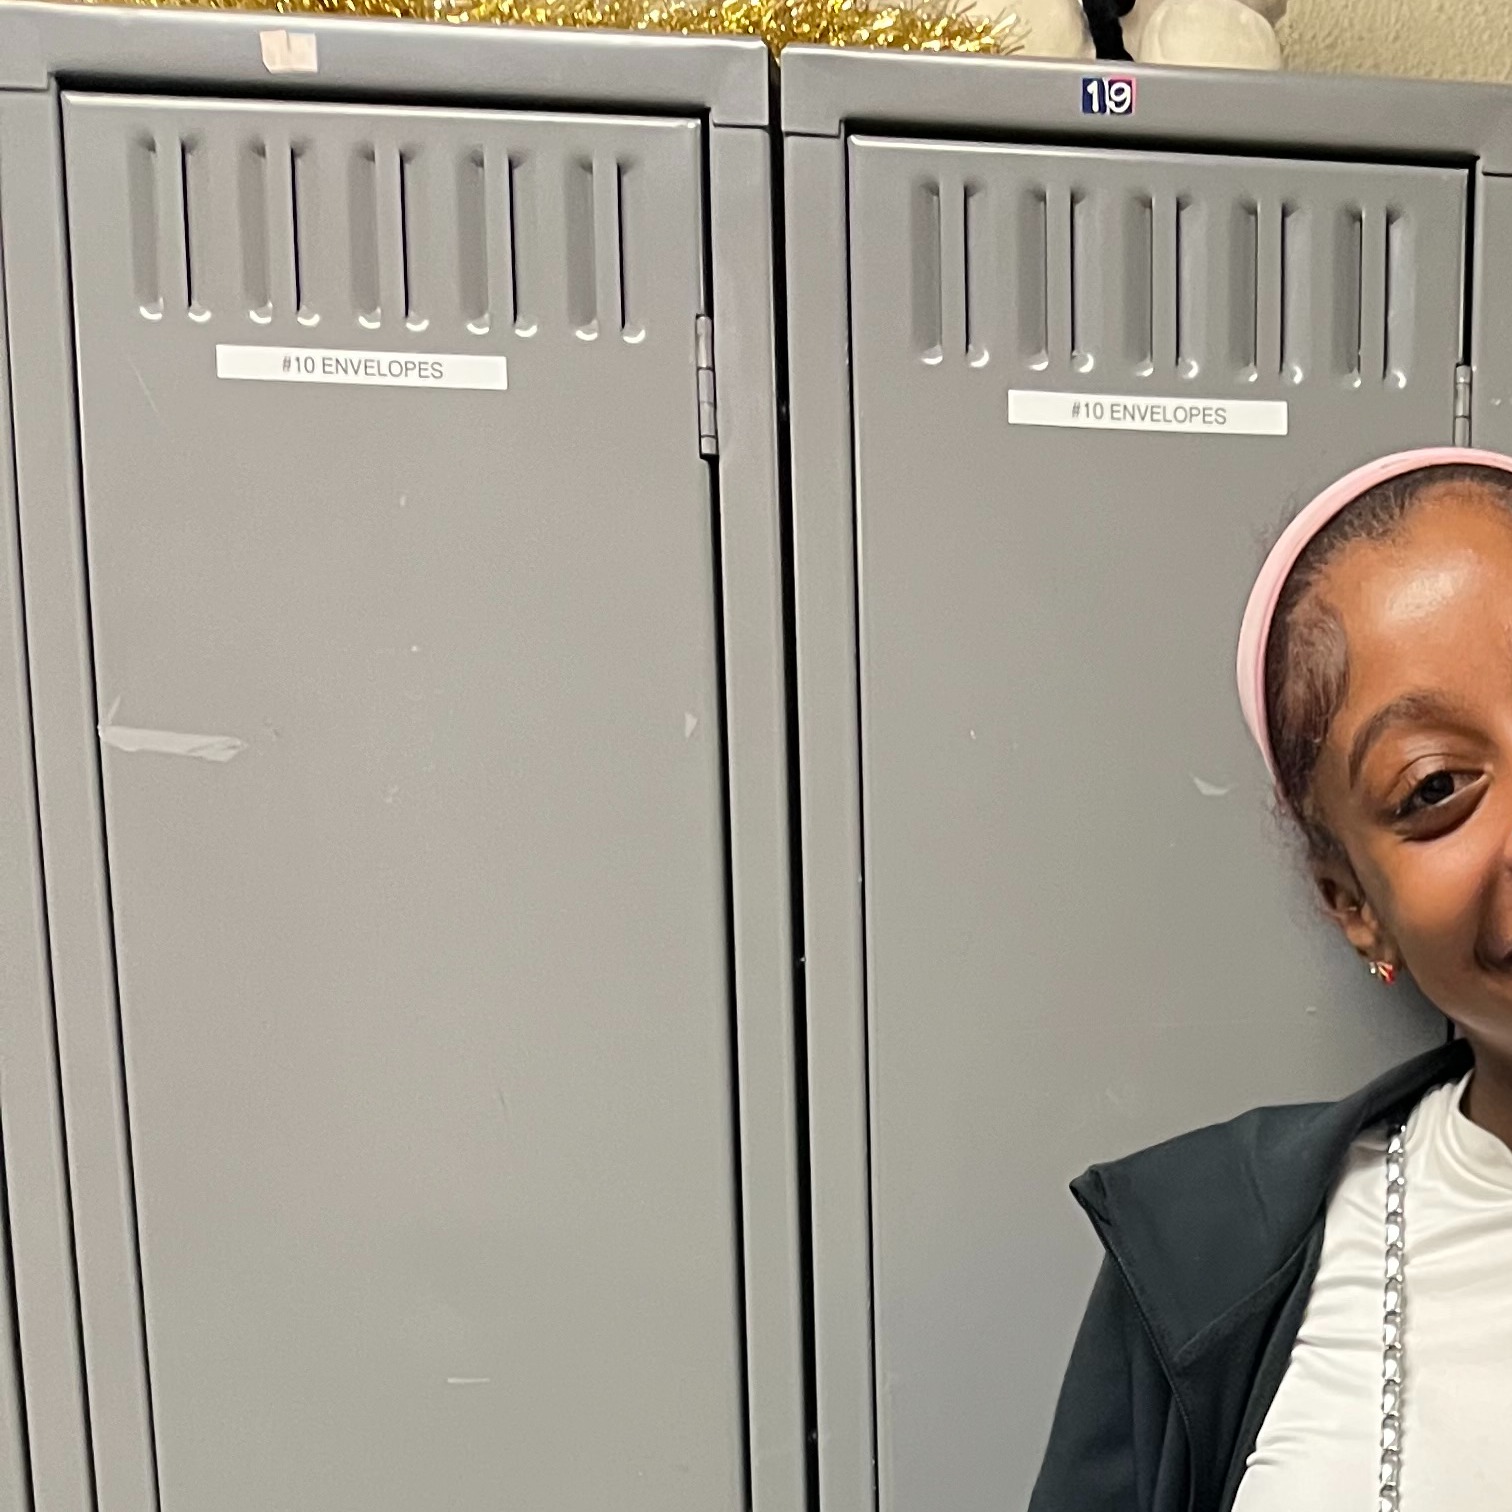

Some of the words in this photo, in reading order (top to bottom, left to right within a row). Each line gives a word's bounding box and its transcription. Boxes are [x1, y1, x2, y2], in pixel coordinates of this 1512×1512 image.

[1086, 80, 1132, 114] 19
[282, 355, 316, 374] #10
[321, 356, 444, 380] ENVELOPES
[1071, 401, 1105, 420] #10
[1110, 403, 1227, 425] ENVELOPES
